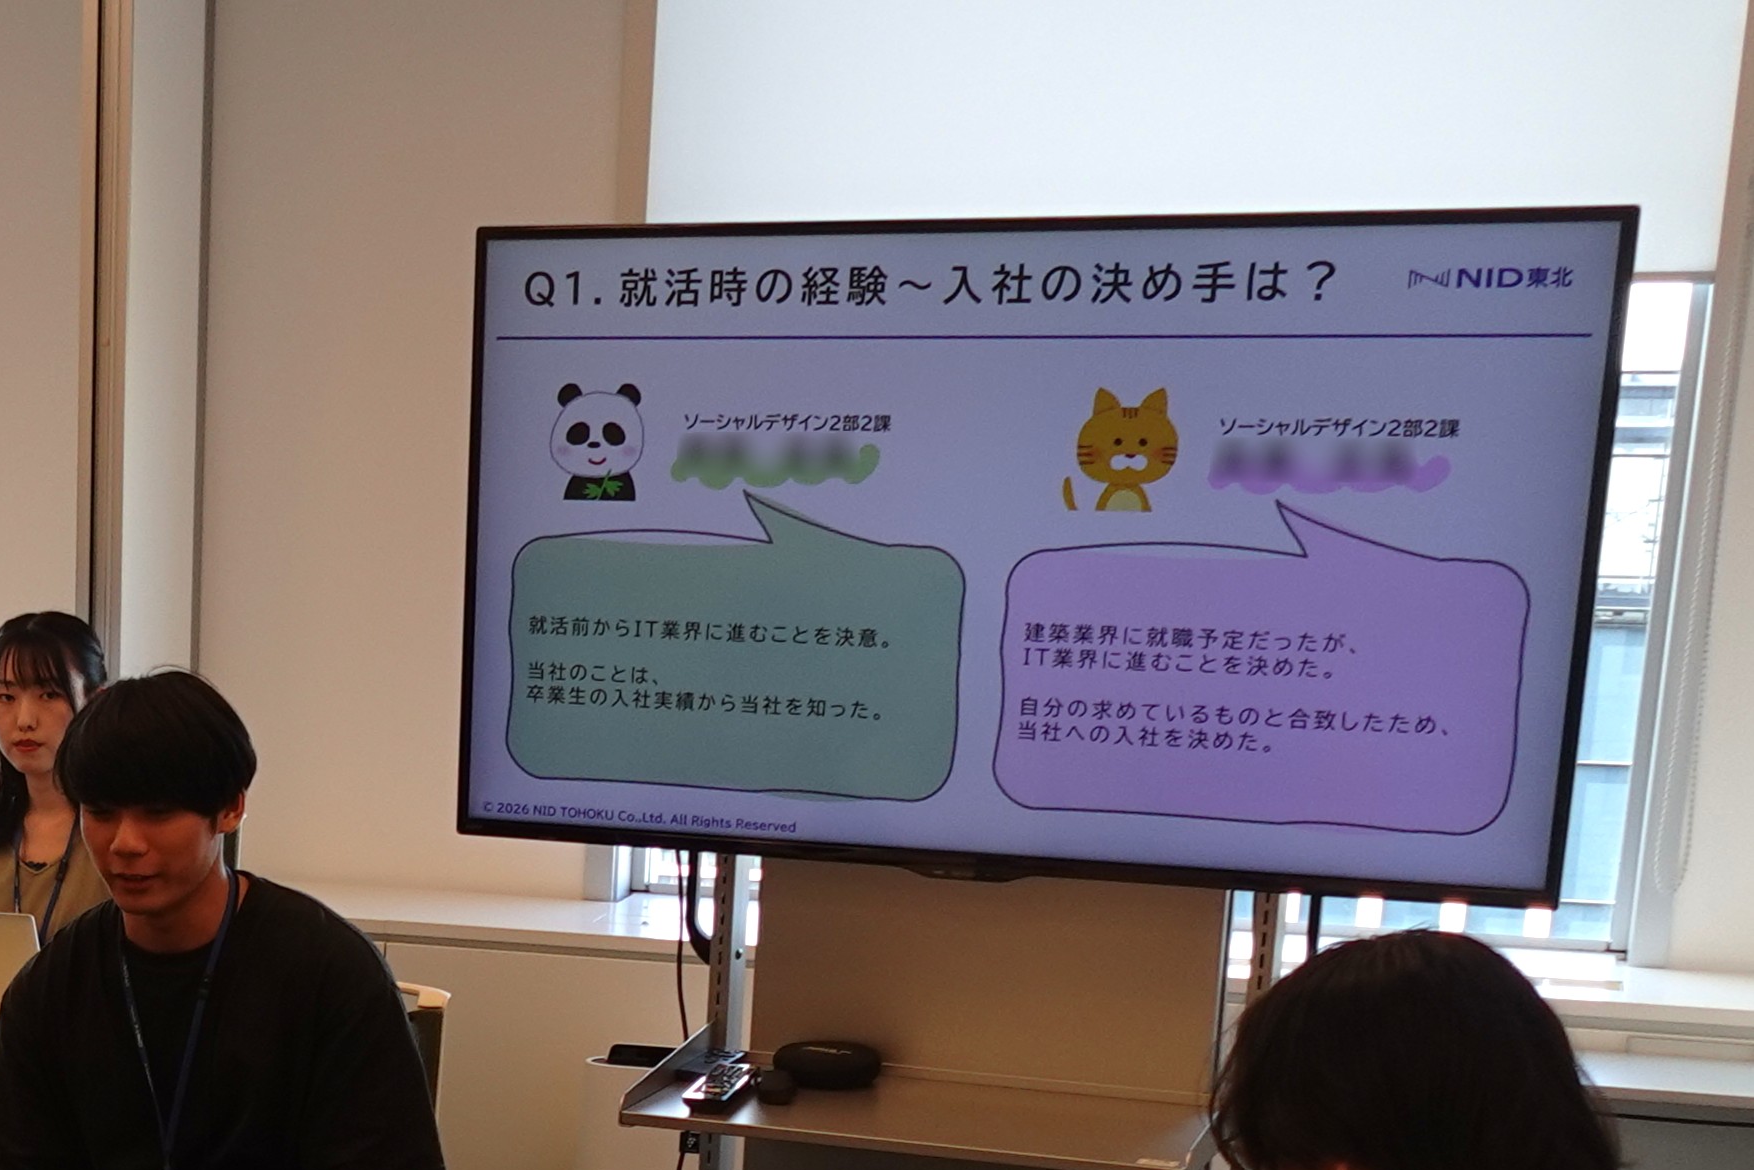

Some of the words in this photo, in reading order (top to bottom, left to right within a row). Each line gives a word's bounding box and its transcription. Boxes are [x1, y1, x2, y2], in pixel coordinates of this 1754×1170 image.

[684, 413, 892, 432] ソーシャルデザイン2部2課
[1220, 417, 1460, 439] ソーシャルデザイン2部2課
[528, 614, 890, 649] 就活前からIT業界に進むことを決意。
[1024, 622, 1356, 655] 建築業界に就職予定だったが、
[527, 661, 659, 686] 当社のことは、
[1022, 647, 1333, 680] IT業界に進むことを決めた。
[526, 684, 882, 721] 卒業生の入社実績から当社を知った。
[1019, 696, 1450, 736] 自分の求めているものと合致したため、
[1017, 721, 1271, 754] 当社への入社を決めた。
[496, 802, 530, 815] 2026
[533, 805, 557, 817] NID
[559, 806, 615, 821] TOHOKU
[670, 813, 688, 826] All
[691, 815, 733, 829] Rights
[736, 818, 797, 833] Reserved
